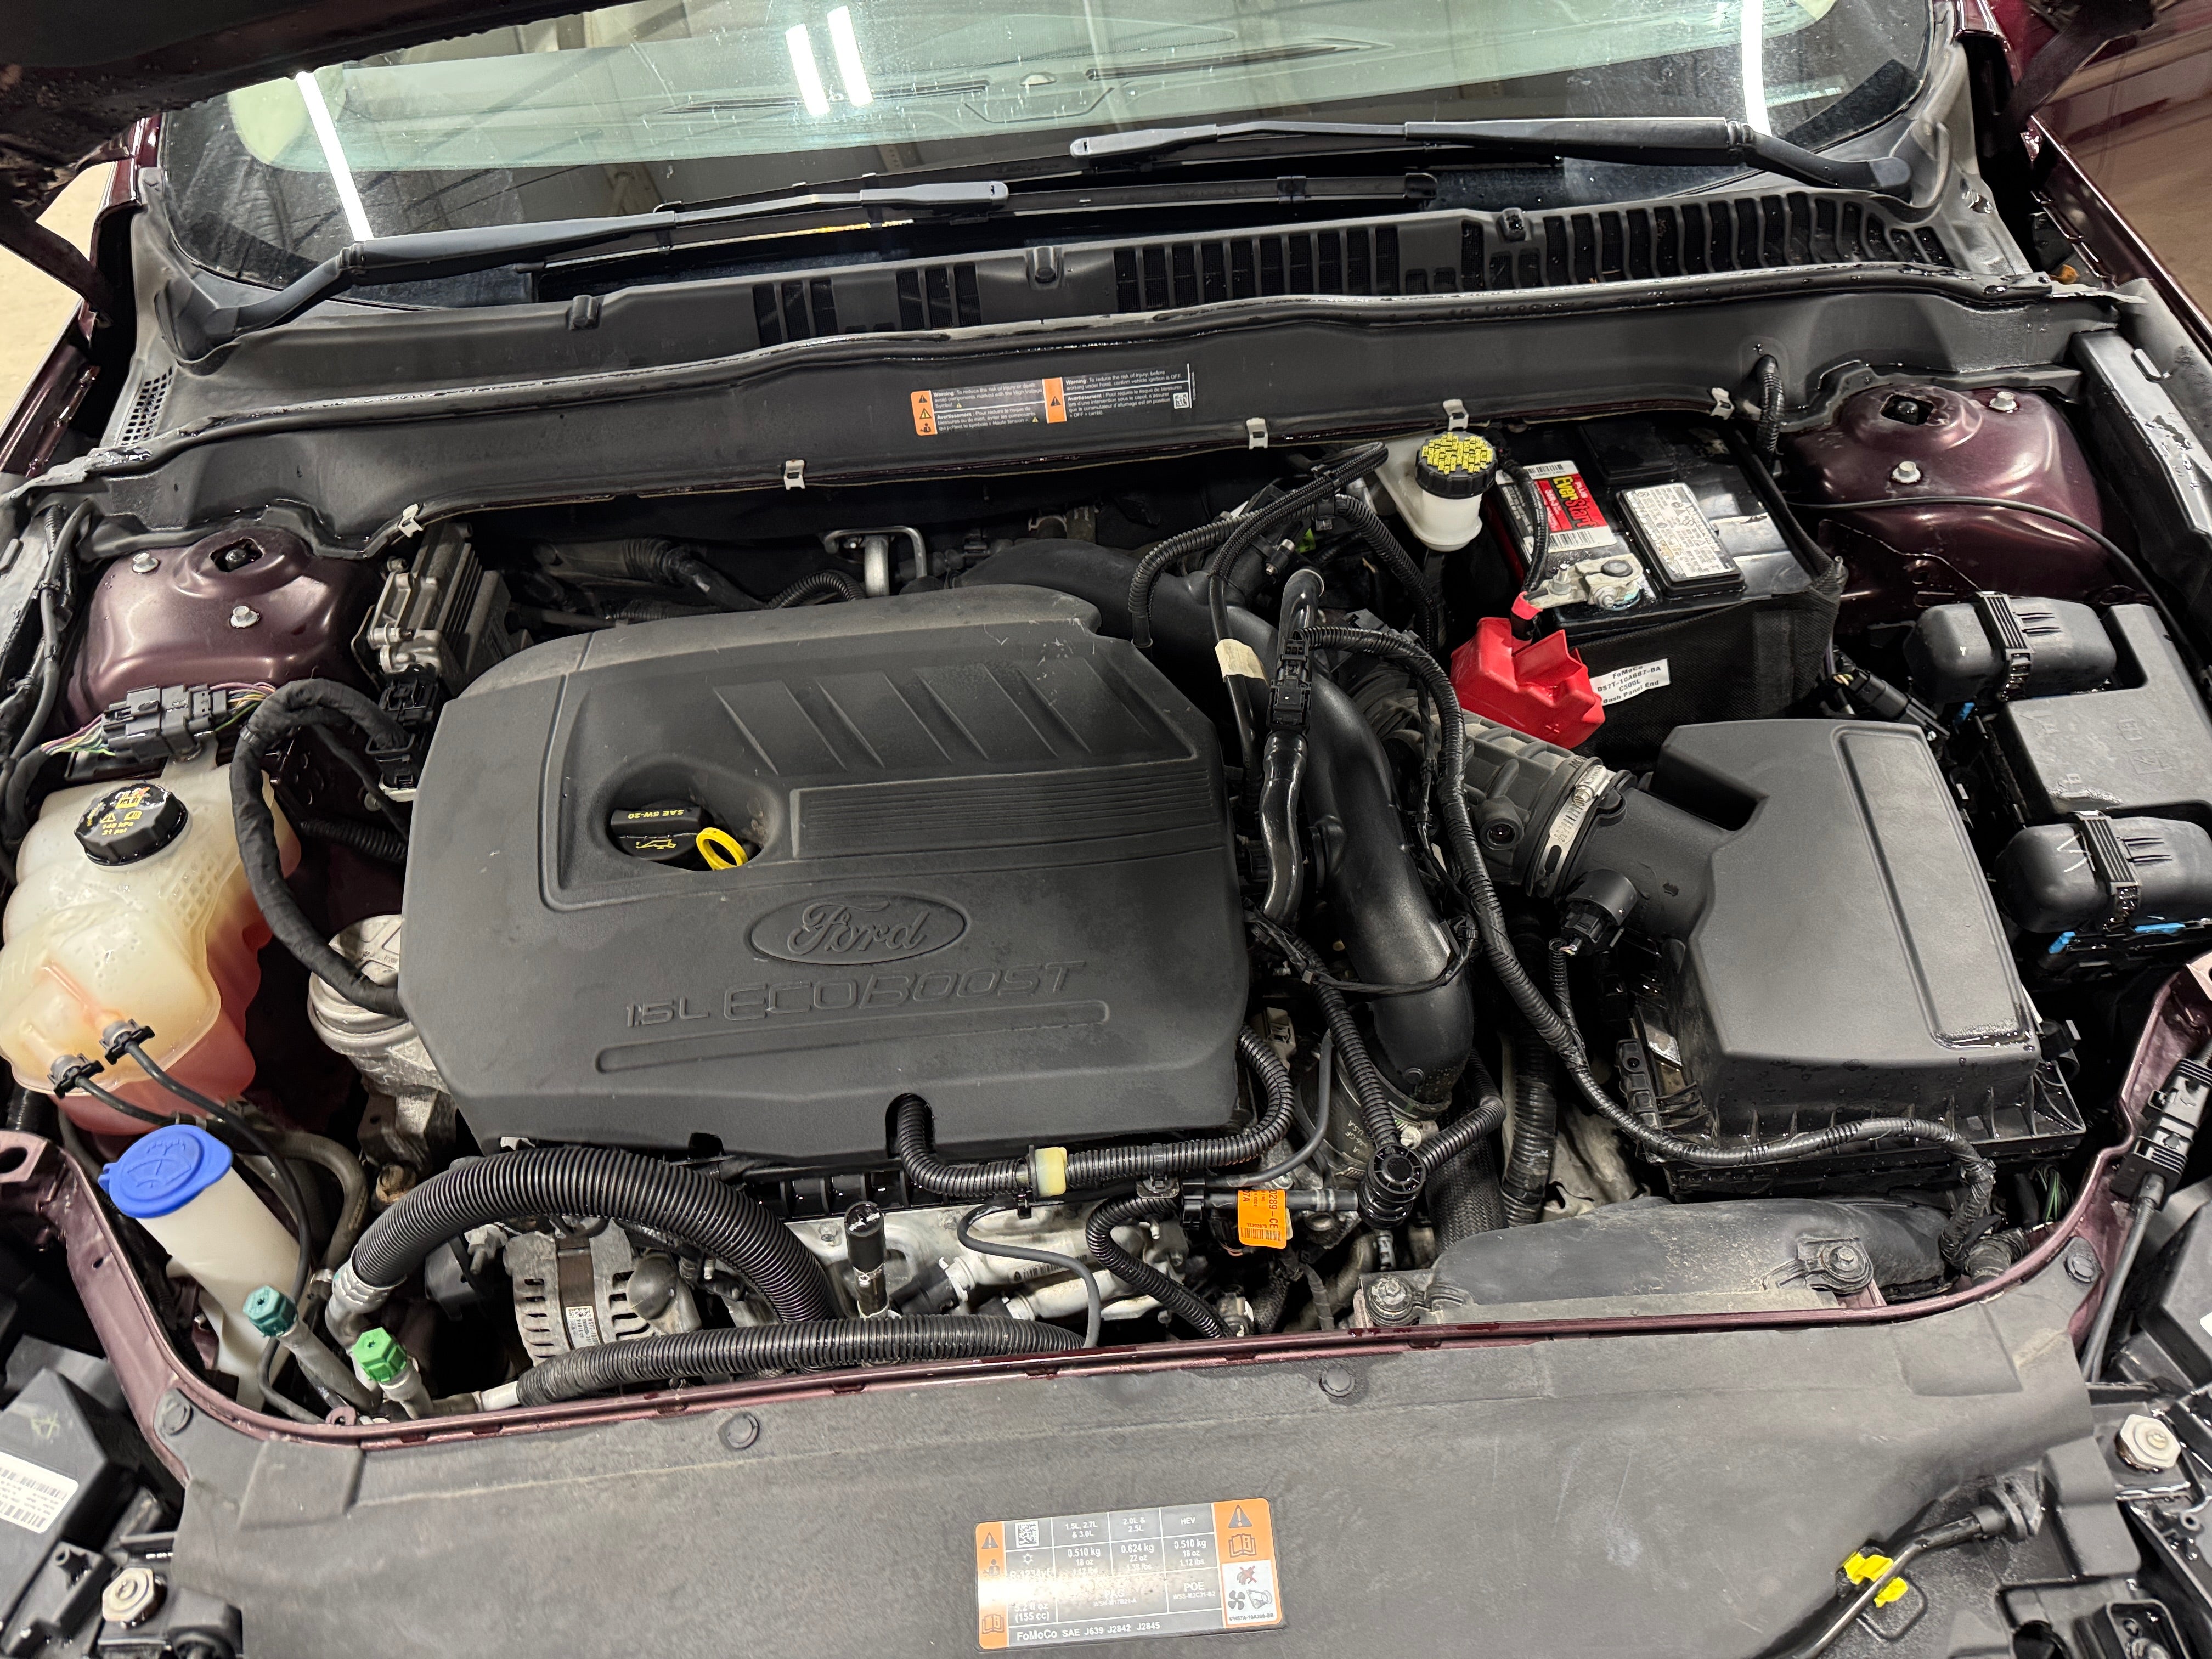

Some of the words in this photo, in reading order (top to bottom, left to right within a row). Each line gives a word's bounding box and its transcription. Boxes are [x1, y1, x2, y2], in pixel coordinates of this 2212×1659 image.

[1575, 481, 1588, 499] PLUS
[1553, 476, 1599, 528] EverStart
[1612, 665, 1643, 679] FoMoCo
[1619, 679, 1641, 692] C500L
[1603, 695, 1622, 704] Dash
[1623, 685, 1643, 698] Panel
[628, 811, 660, 819] 5W-20
[787, 898, 932, 955] Ford
[724, 961, 1086, 1022] ECOBOOST
[1079, 1529, 1094, 1537] 3.0L
[1121, 1544, 1142, 1553] 0.624
[1143, 1542, 1154, 1553] kg
[1173, 1539, 1195, 1548] 0.510
[1196, 1537, 1206, 1548] kg
[1067, 1548, 1088, 1558] 0.510
[1090, 1546, 1101, 1557] kg
[1183, 1582, 1205, 1592] POE
[1104, 1589, 1125, 1599] PAG
[1014, 1612, 1034, 1623] (155
[1036, 1610, 1049, 1621] cc)
[1017, 1629, 1057, 1641] FoMoCo
[1062, 1628, 1080, 1637] SAE
[1084, 1626, 1103, 1635] J639
[1107, 1624, 1131, 1633] J2842
[1136, 1621, 1160, 1630] J2845
